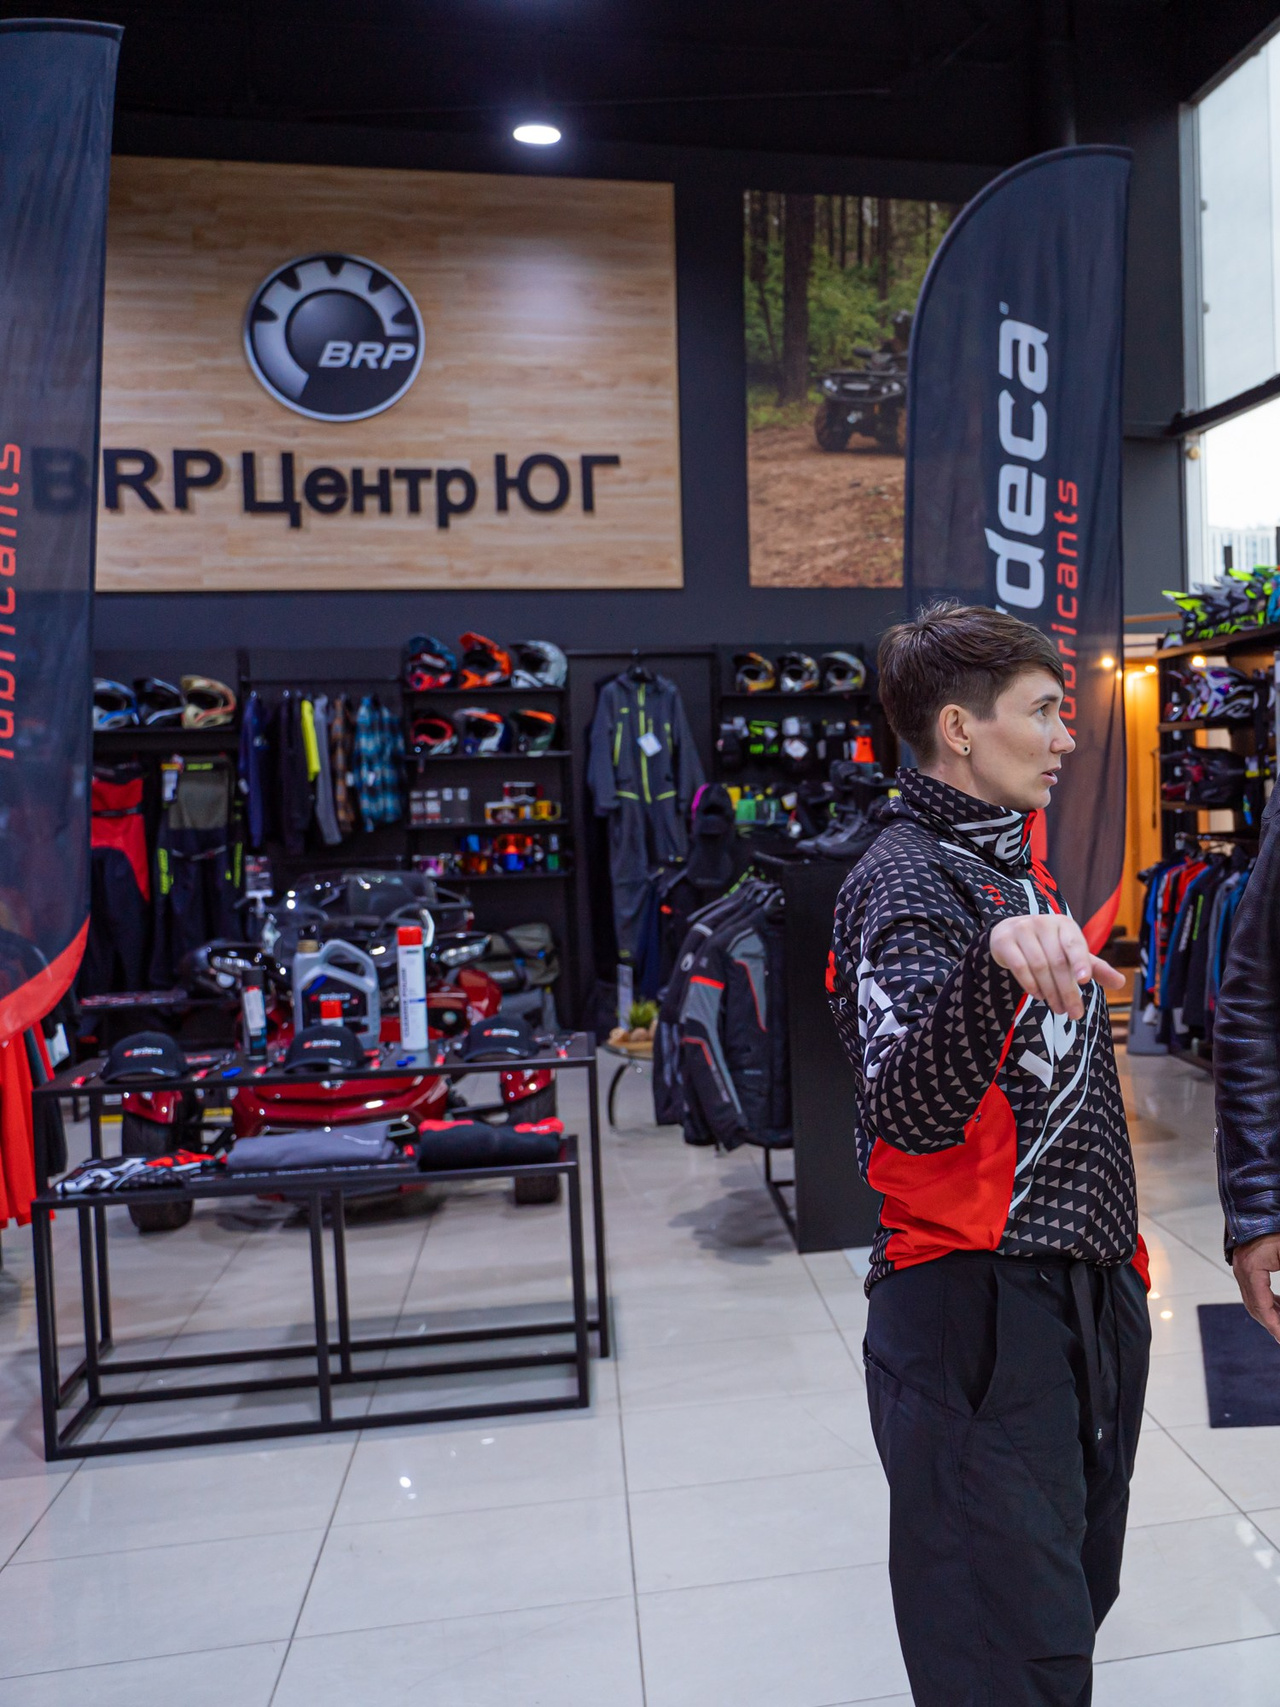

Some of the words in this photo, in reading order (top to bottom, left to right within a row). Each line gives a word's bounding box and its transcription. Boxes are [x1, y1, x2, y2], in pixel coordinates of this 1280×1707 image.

[318, 342, 415, 370] BRP
[31, 447, 223, 513] BRP
[241, 451, 478, 530] Центр
[494, 453, 620, 514] ЮГ
